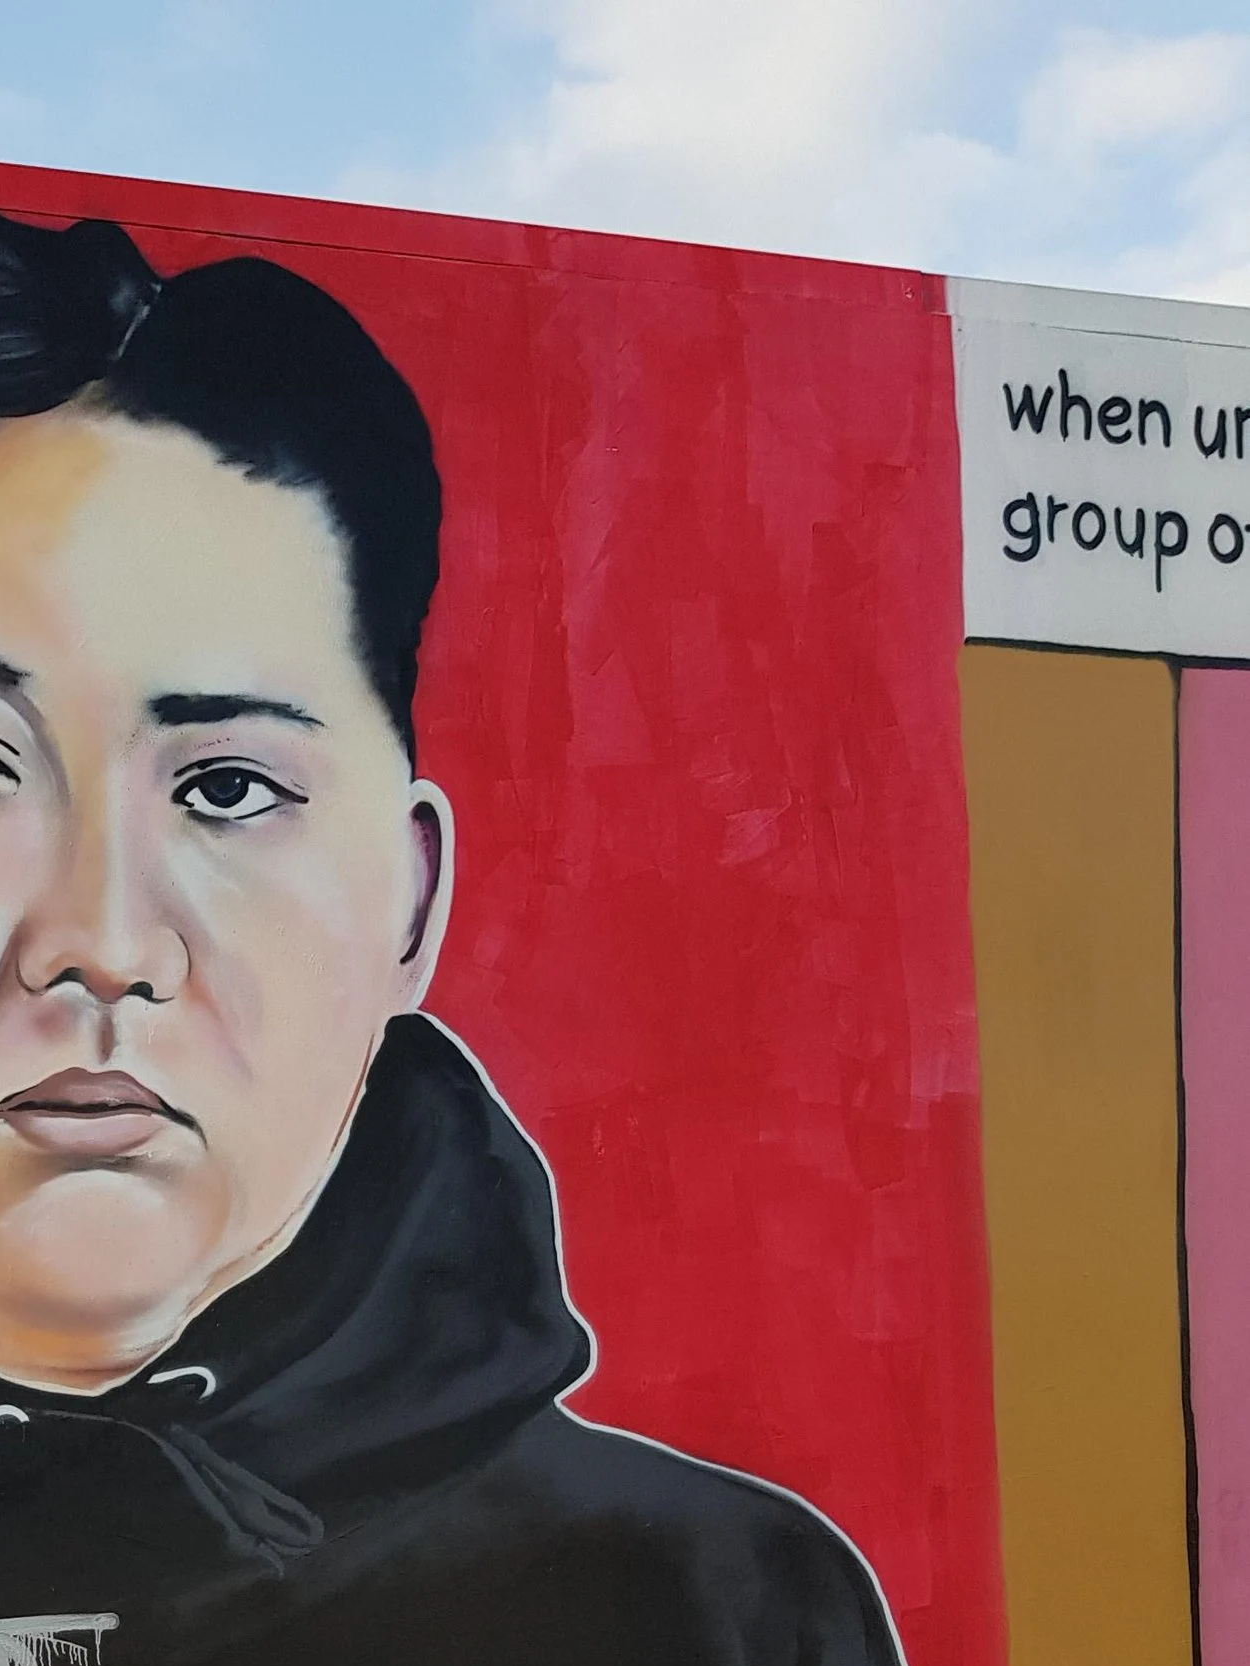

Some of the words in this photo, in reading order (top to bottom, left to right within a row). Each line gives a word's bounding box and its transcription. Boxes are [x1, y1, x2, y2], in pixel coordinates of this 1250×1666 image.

[1002, 367, 1172, 448] when
[1002, 491, 1189, 593] group
[1207, 513, 1250, 564] o
